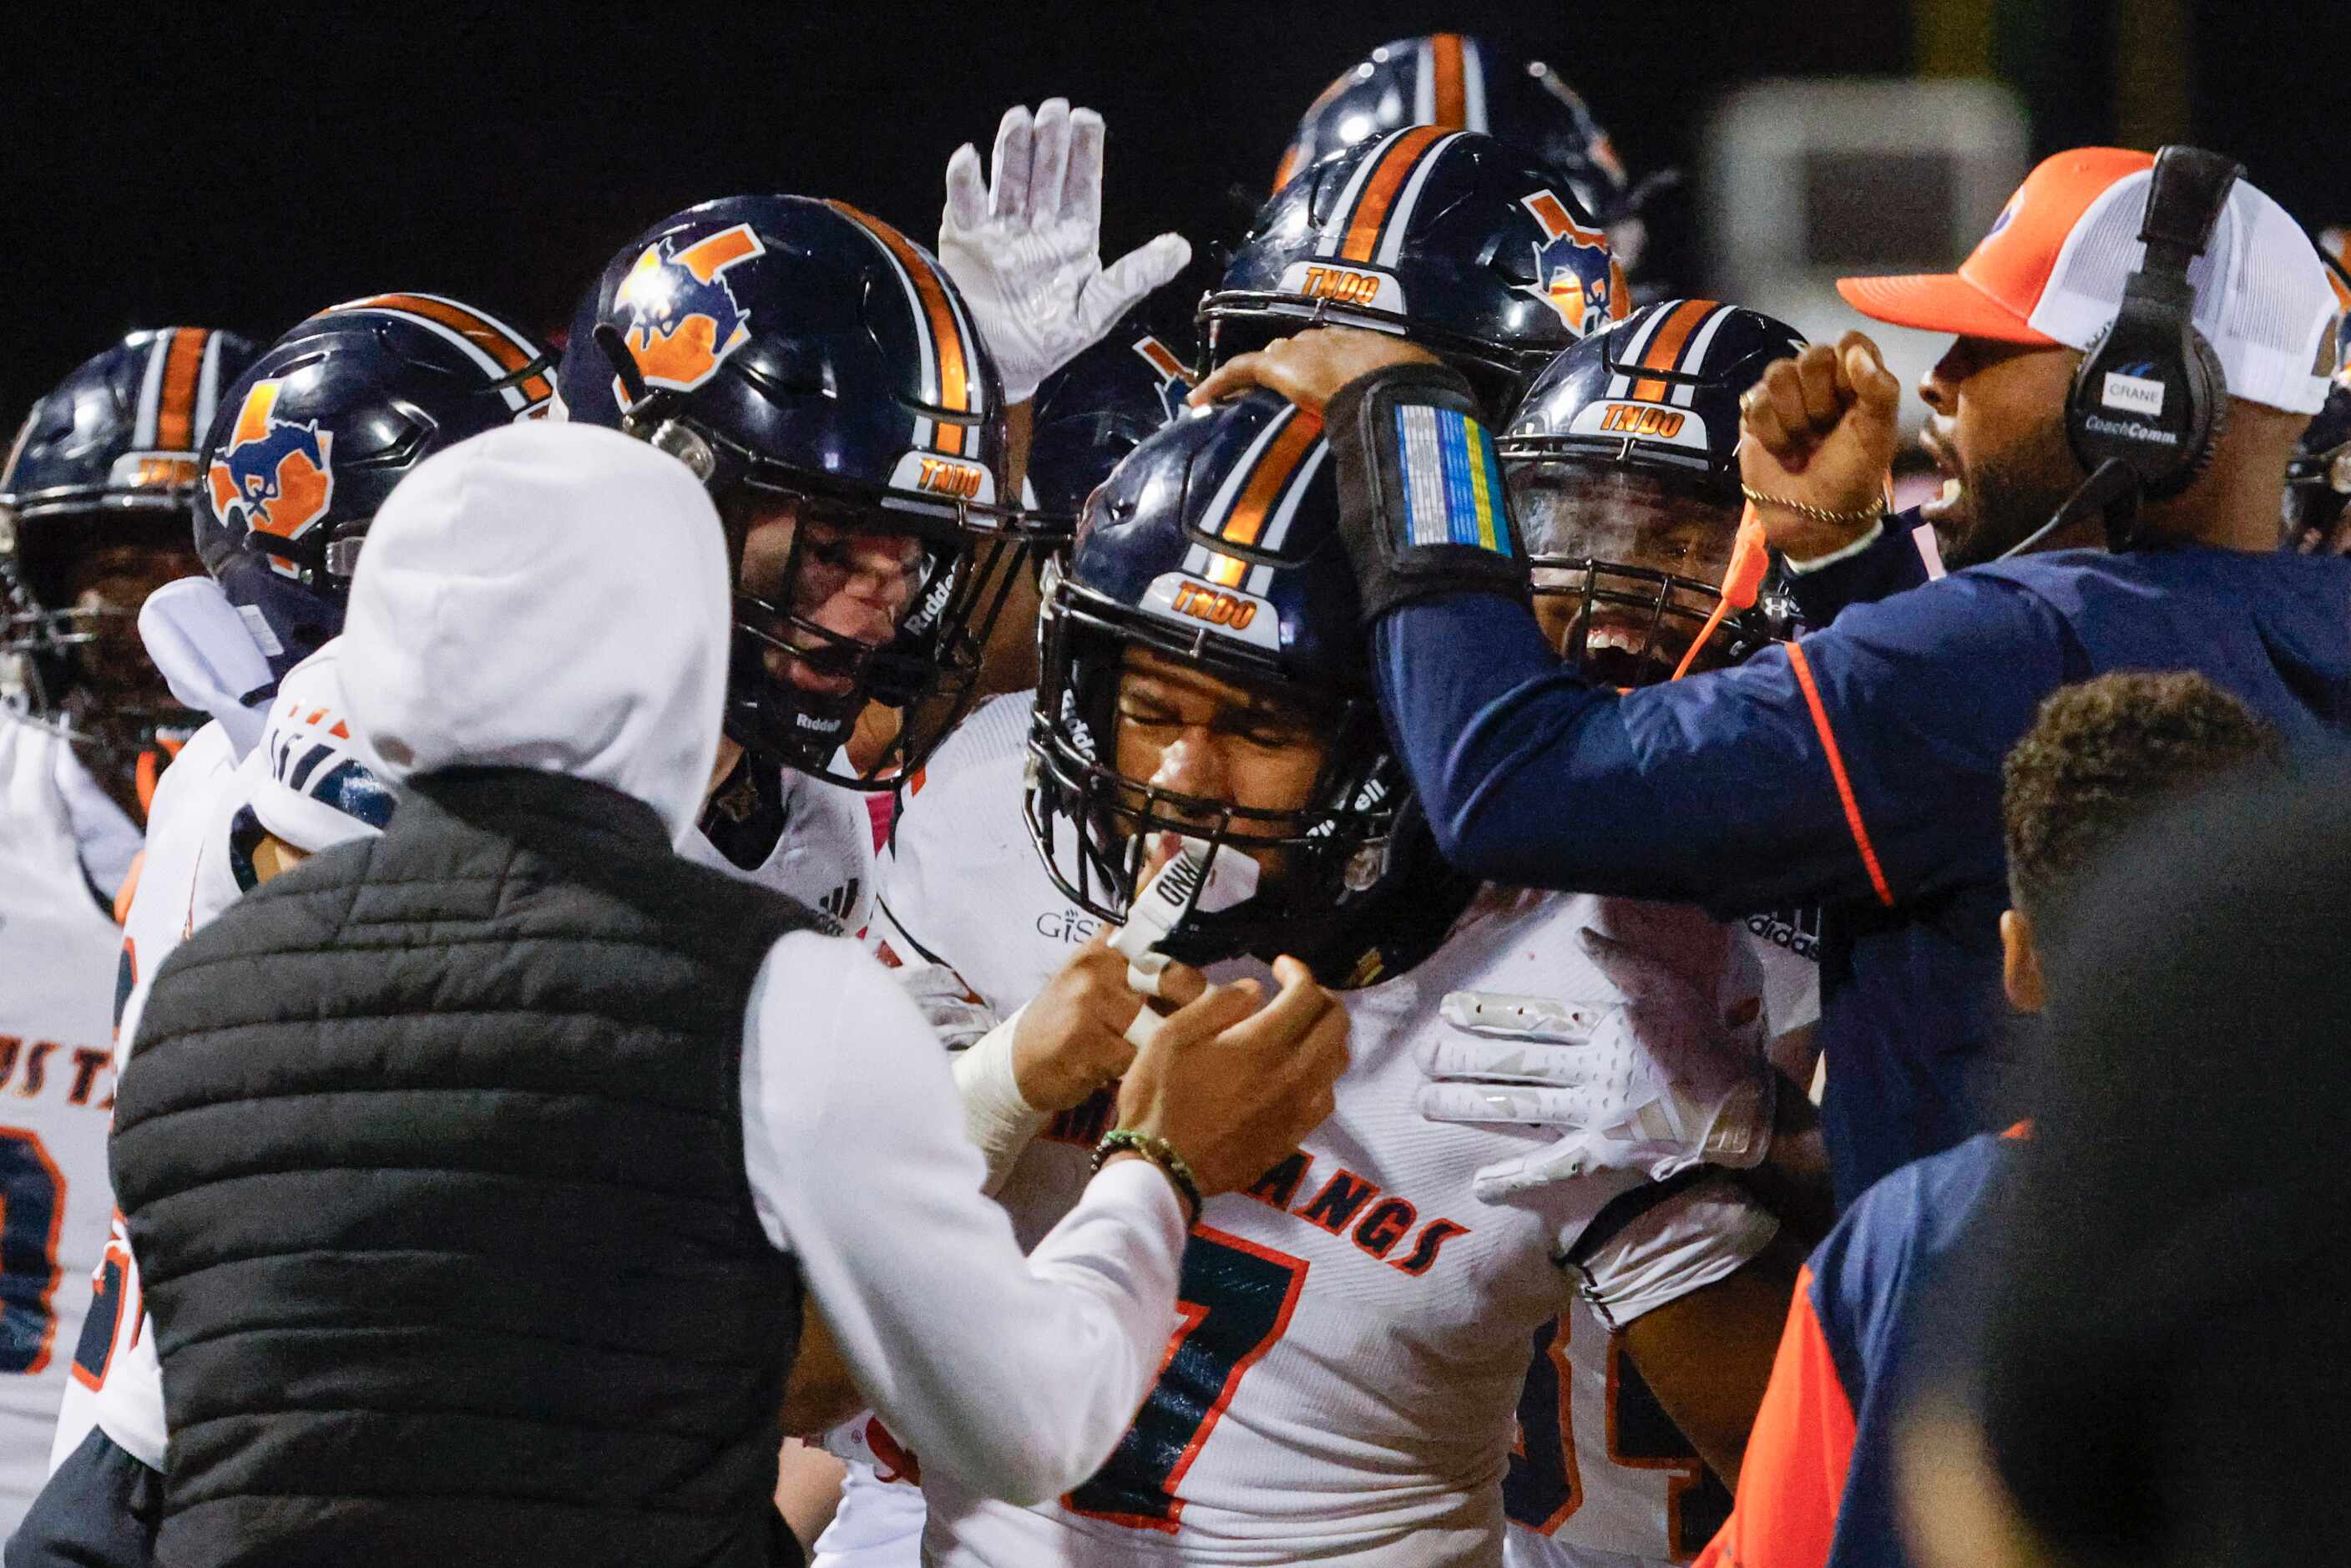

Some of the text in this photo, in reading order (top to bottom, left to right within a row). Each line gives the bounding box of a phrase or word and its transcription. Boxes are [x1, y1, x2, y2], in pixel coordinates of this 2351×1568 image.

[1302, 266, 1380, 304] TNDO
[2109, 383, 2160, 402] CRANE
[1600, 403, 1686, 438] TNDO
[1171, 579, 1256, 630] TNDO
